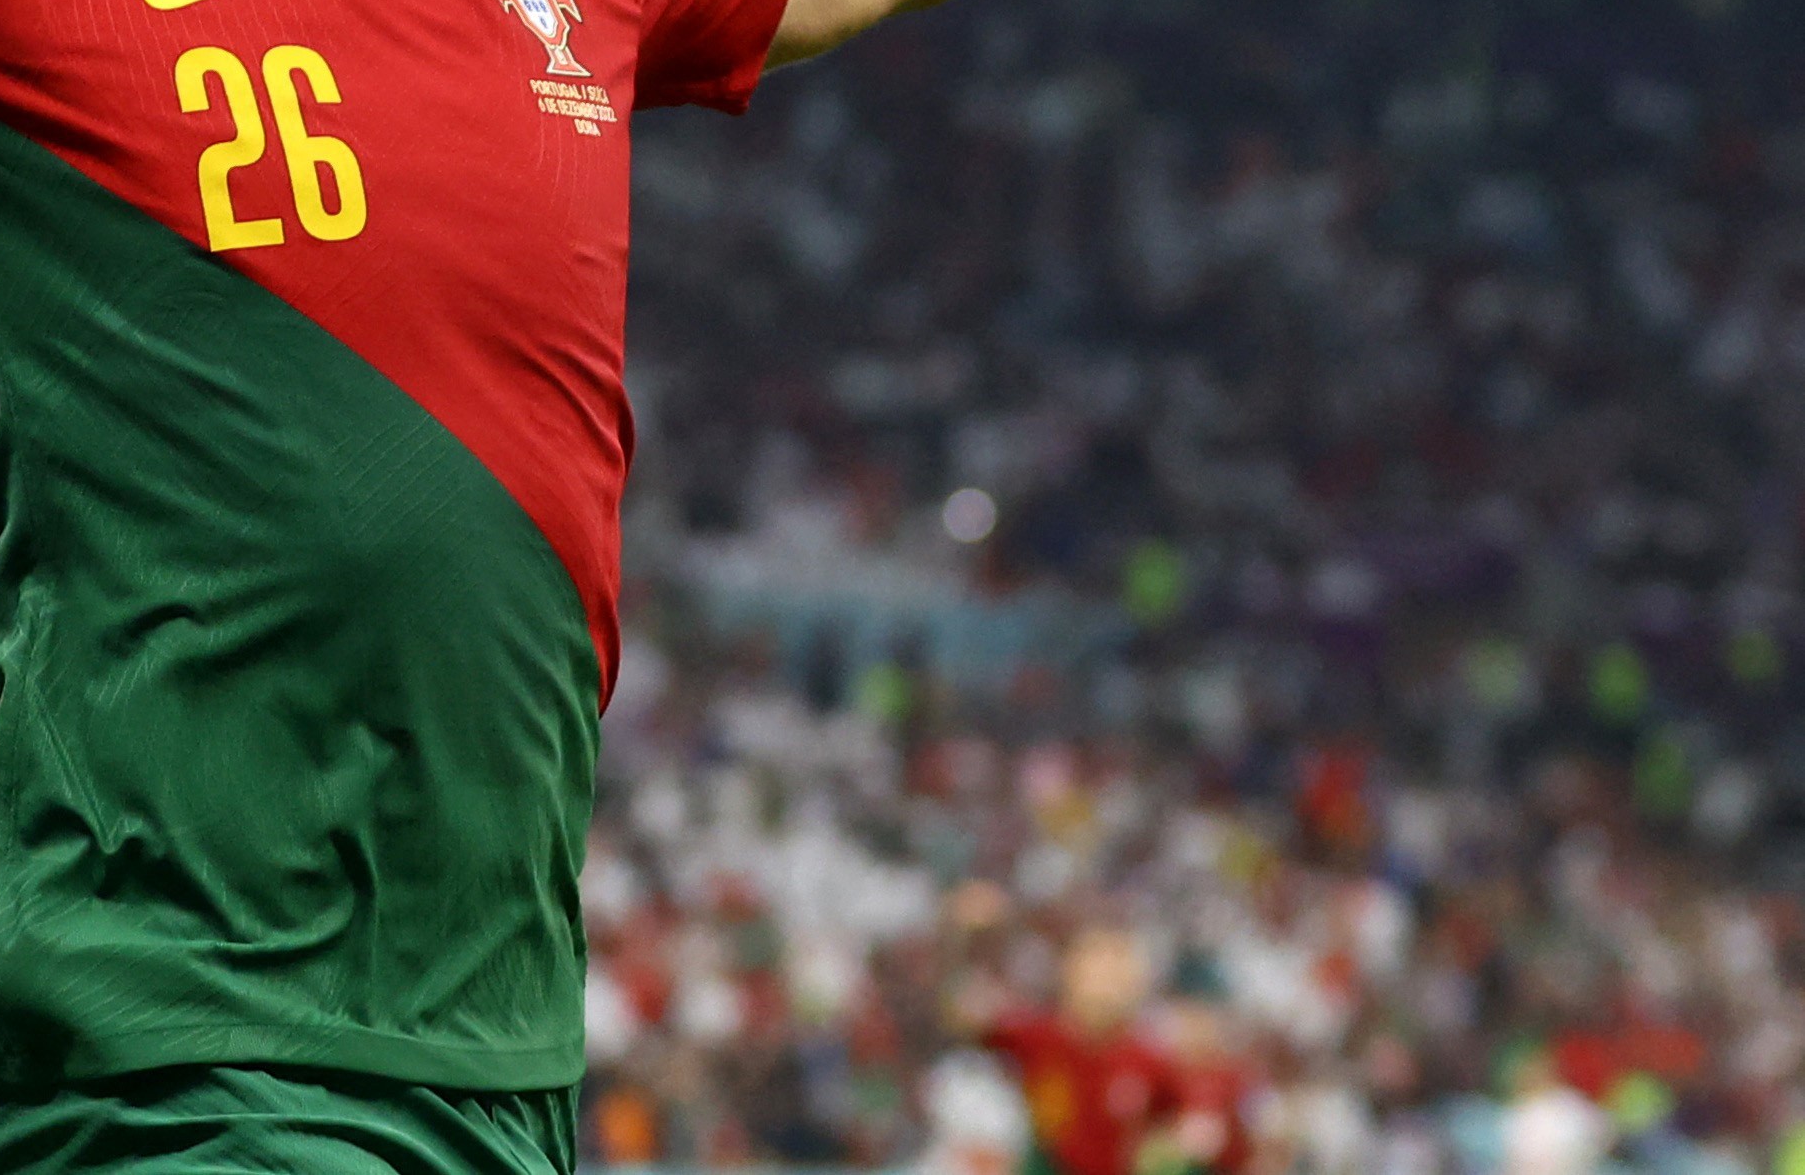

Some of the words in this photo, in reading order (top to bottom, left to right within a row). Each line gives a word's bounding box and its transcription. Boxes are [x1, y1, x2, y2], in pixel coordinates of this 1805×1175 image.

[529, 79, 582, 99] PORTUGAL
[544, 97, 559, 114] DE
[174, 44, 367, 252] 26
